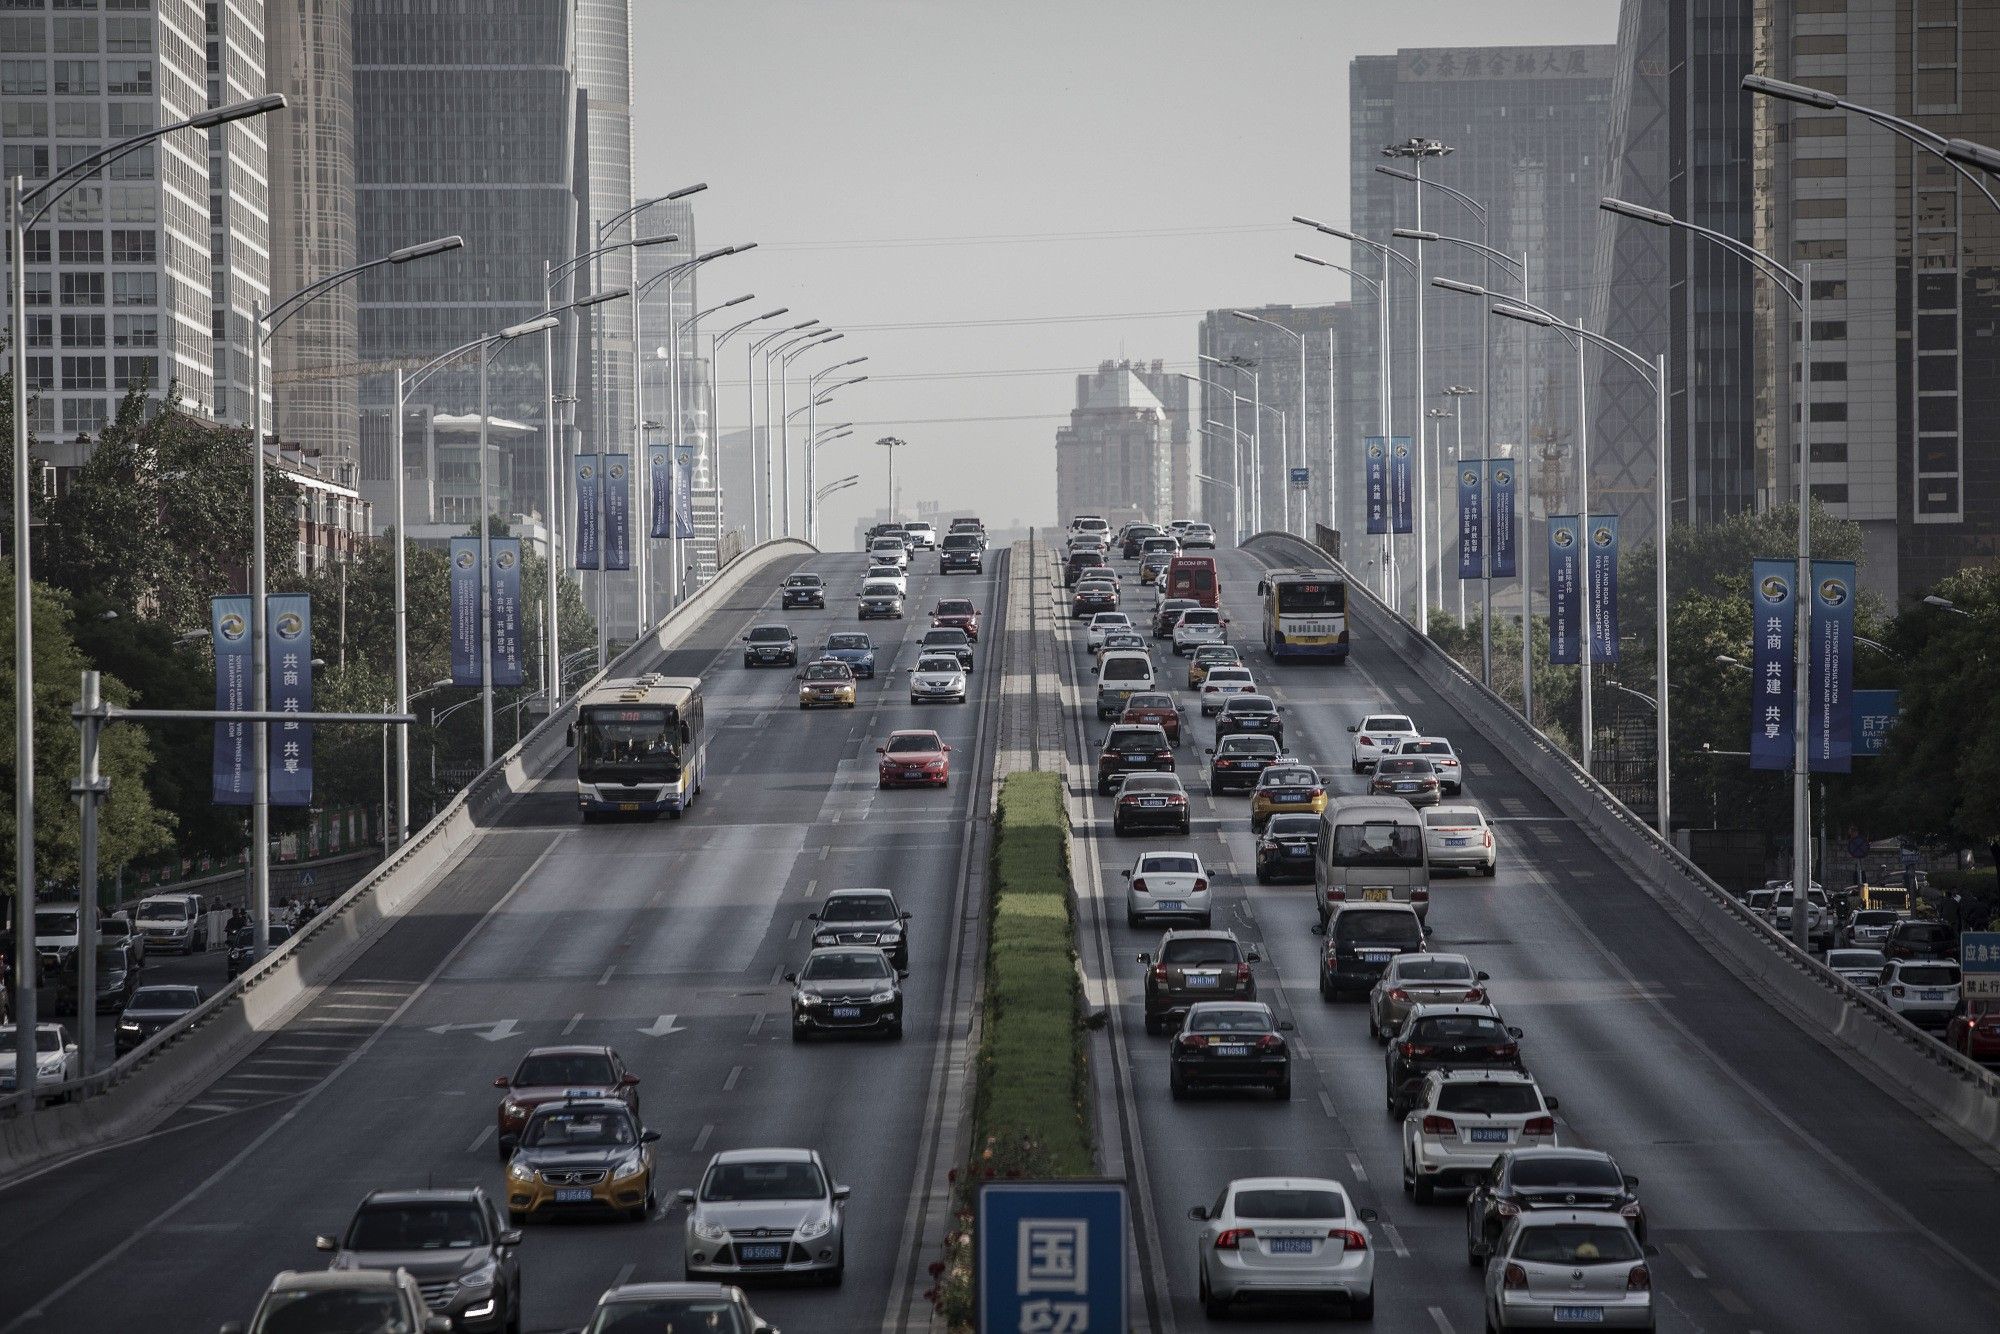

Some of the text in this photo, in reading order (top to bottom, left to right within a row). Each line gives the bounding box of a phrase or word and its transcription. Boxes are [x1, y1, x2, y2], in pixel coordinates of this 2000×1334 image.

[1766, 616, 1782, 650] 共商
[1766, 661, 1782, 695] 共建
[1765, 706, 1780, 739] 共享
[1966, 944, 2000, 962] 应急车
